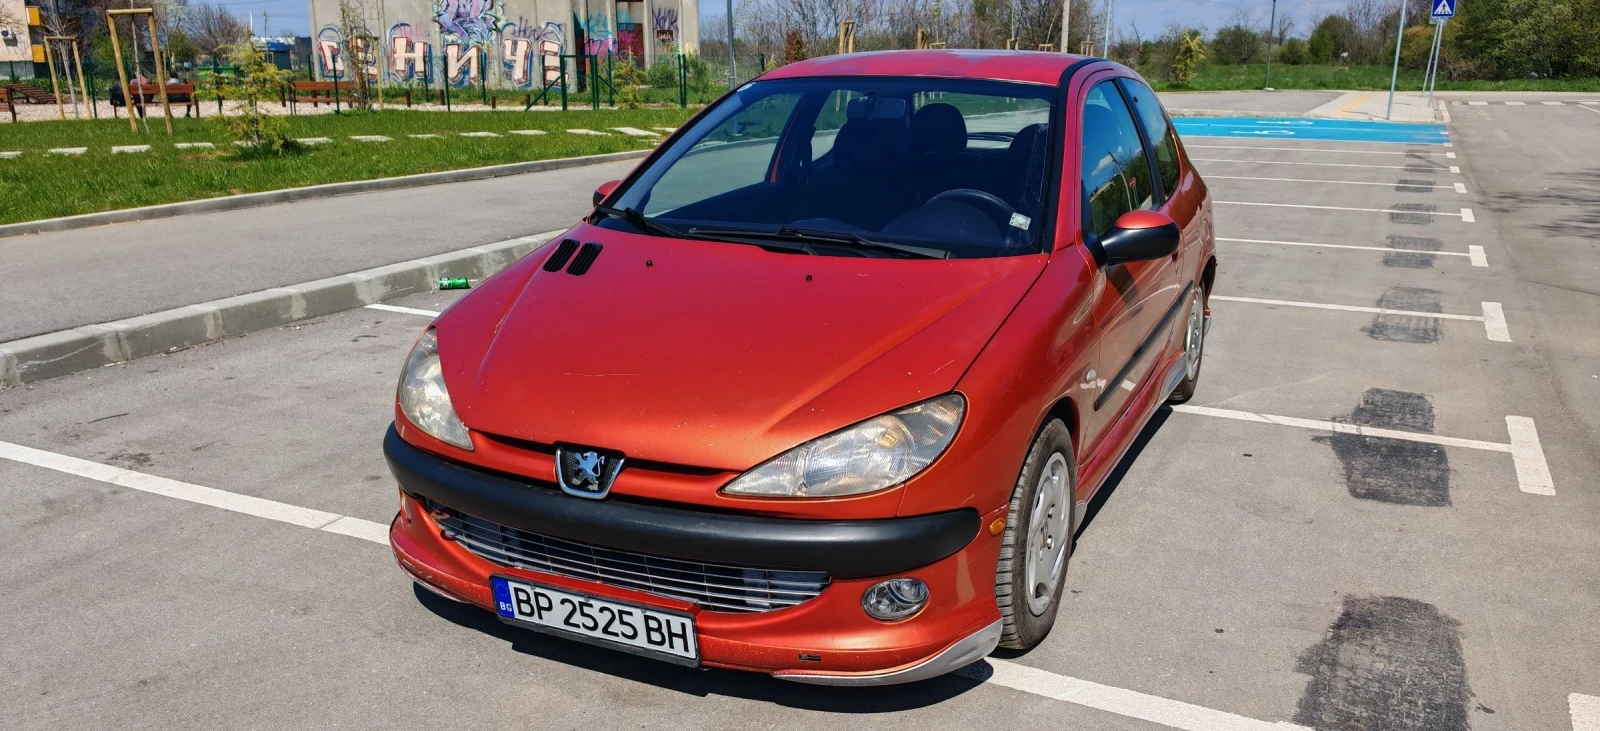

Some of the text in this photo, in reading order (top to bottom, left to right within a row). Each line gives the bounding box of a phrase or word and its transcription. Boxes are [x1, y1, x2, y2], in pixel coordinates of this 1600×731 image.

[499, 601, 513, 612] BG
[513, 586, 690, 653] BP 2525 BH
